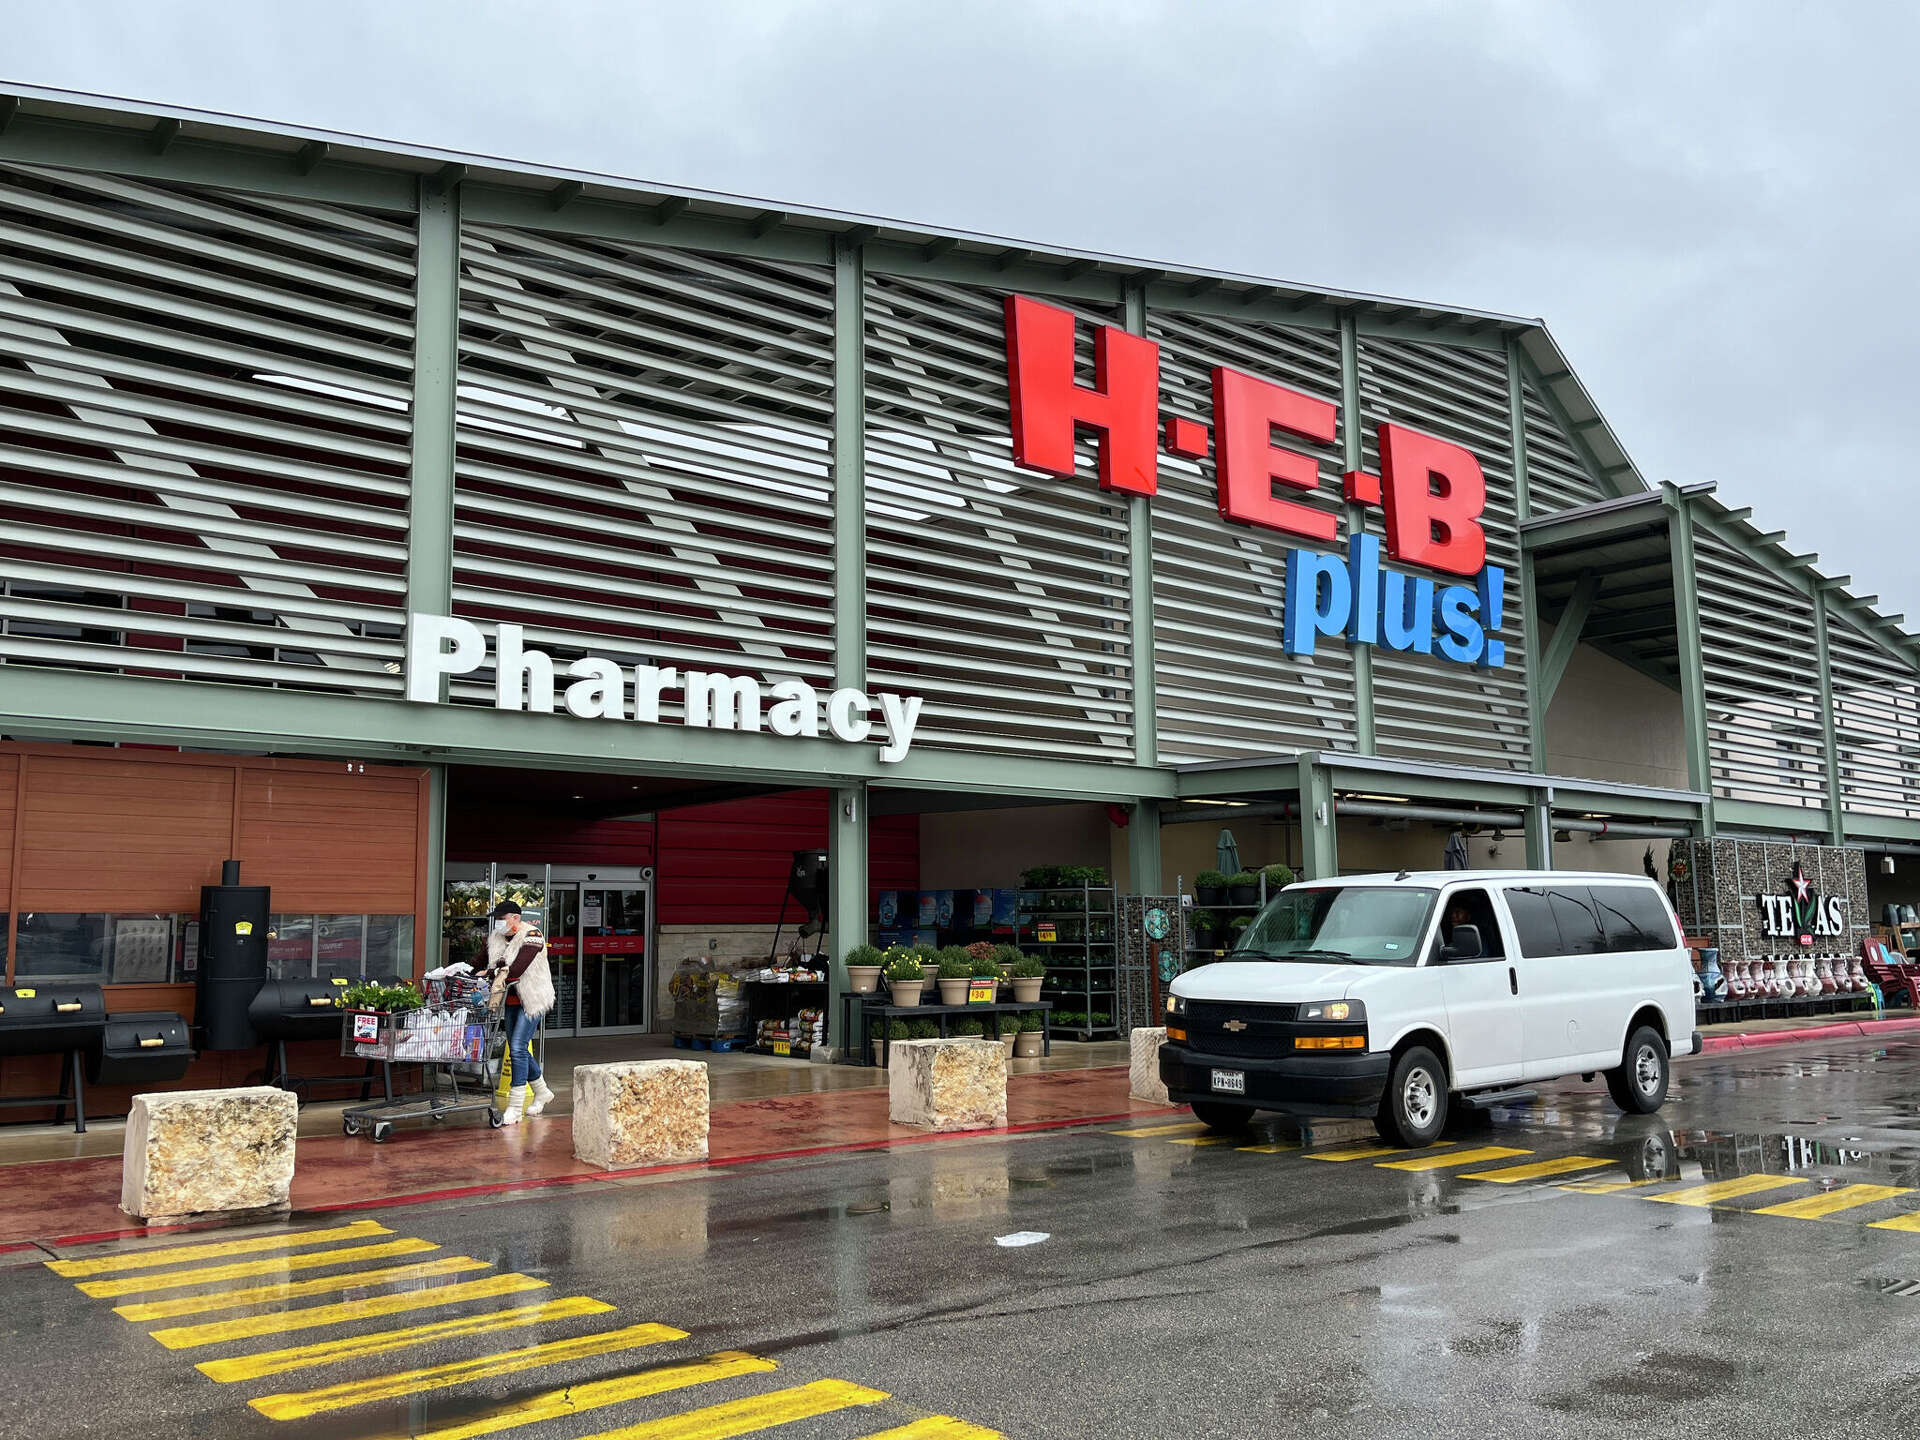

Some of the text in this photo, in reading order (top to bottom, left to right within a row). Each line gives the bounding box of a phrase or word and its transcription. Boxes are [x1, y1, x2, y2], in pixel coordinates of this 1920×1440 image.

[1004, 294, 1487, 575] H-E-B
[1284, 532, 1504, 668] plus!
[406, 612, 923, 763] Pharmacy
[357, 1016, 376, 1025] FREE
